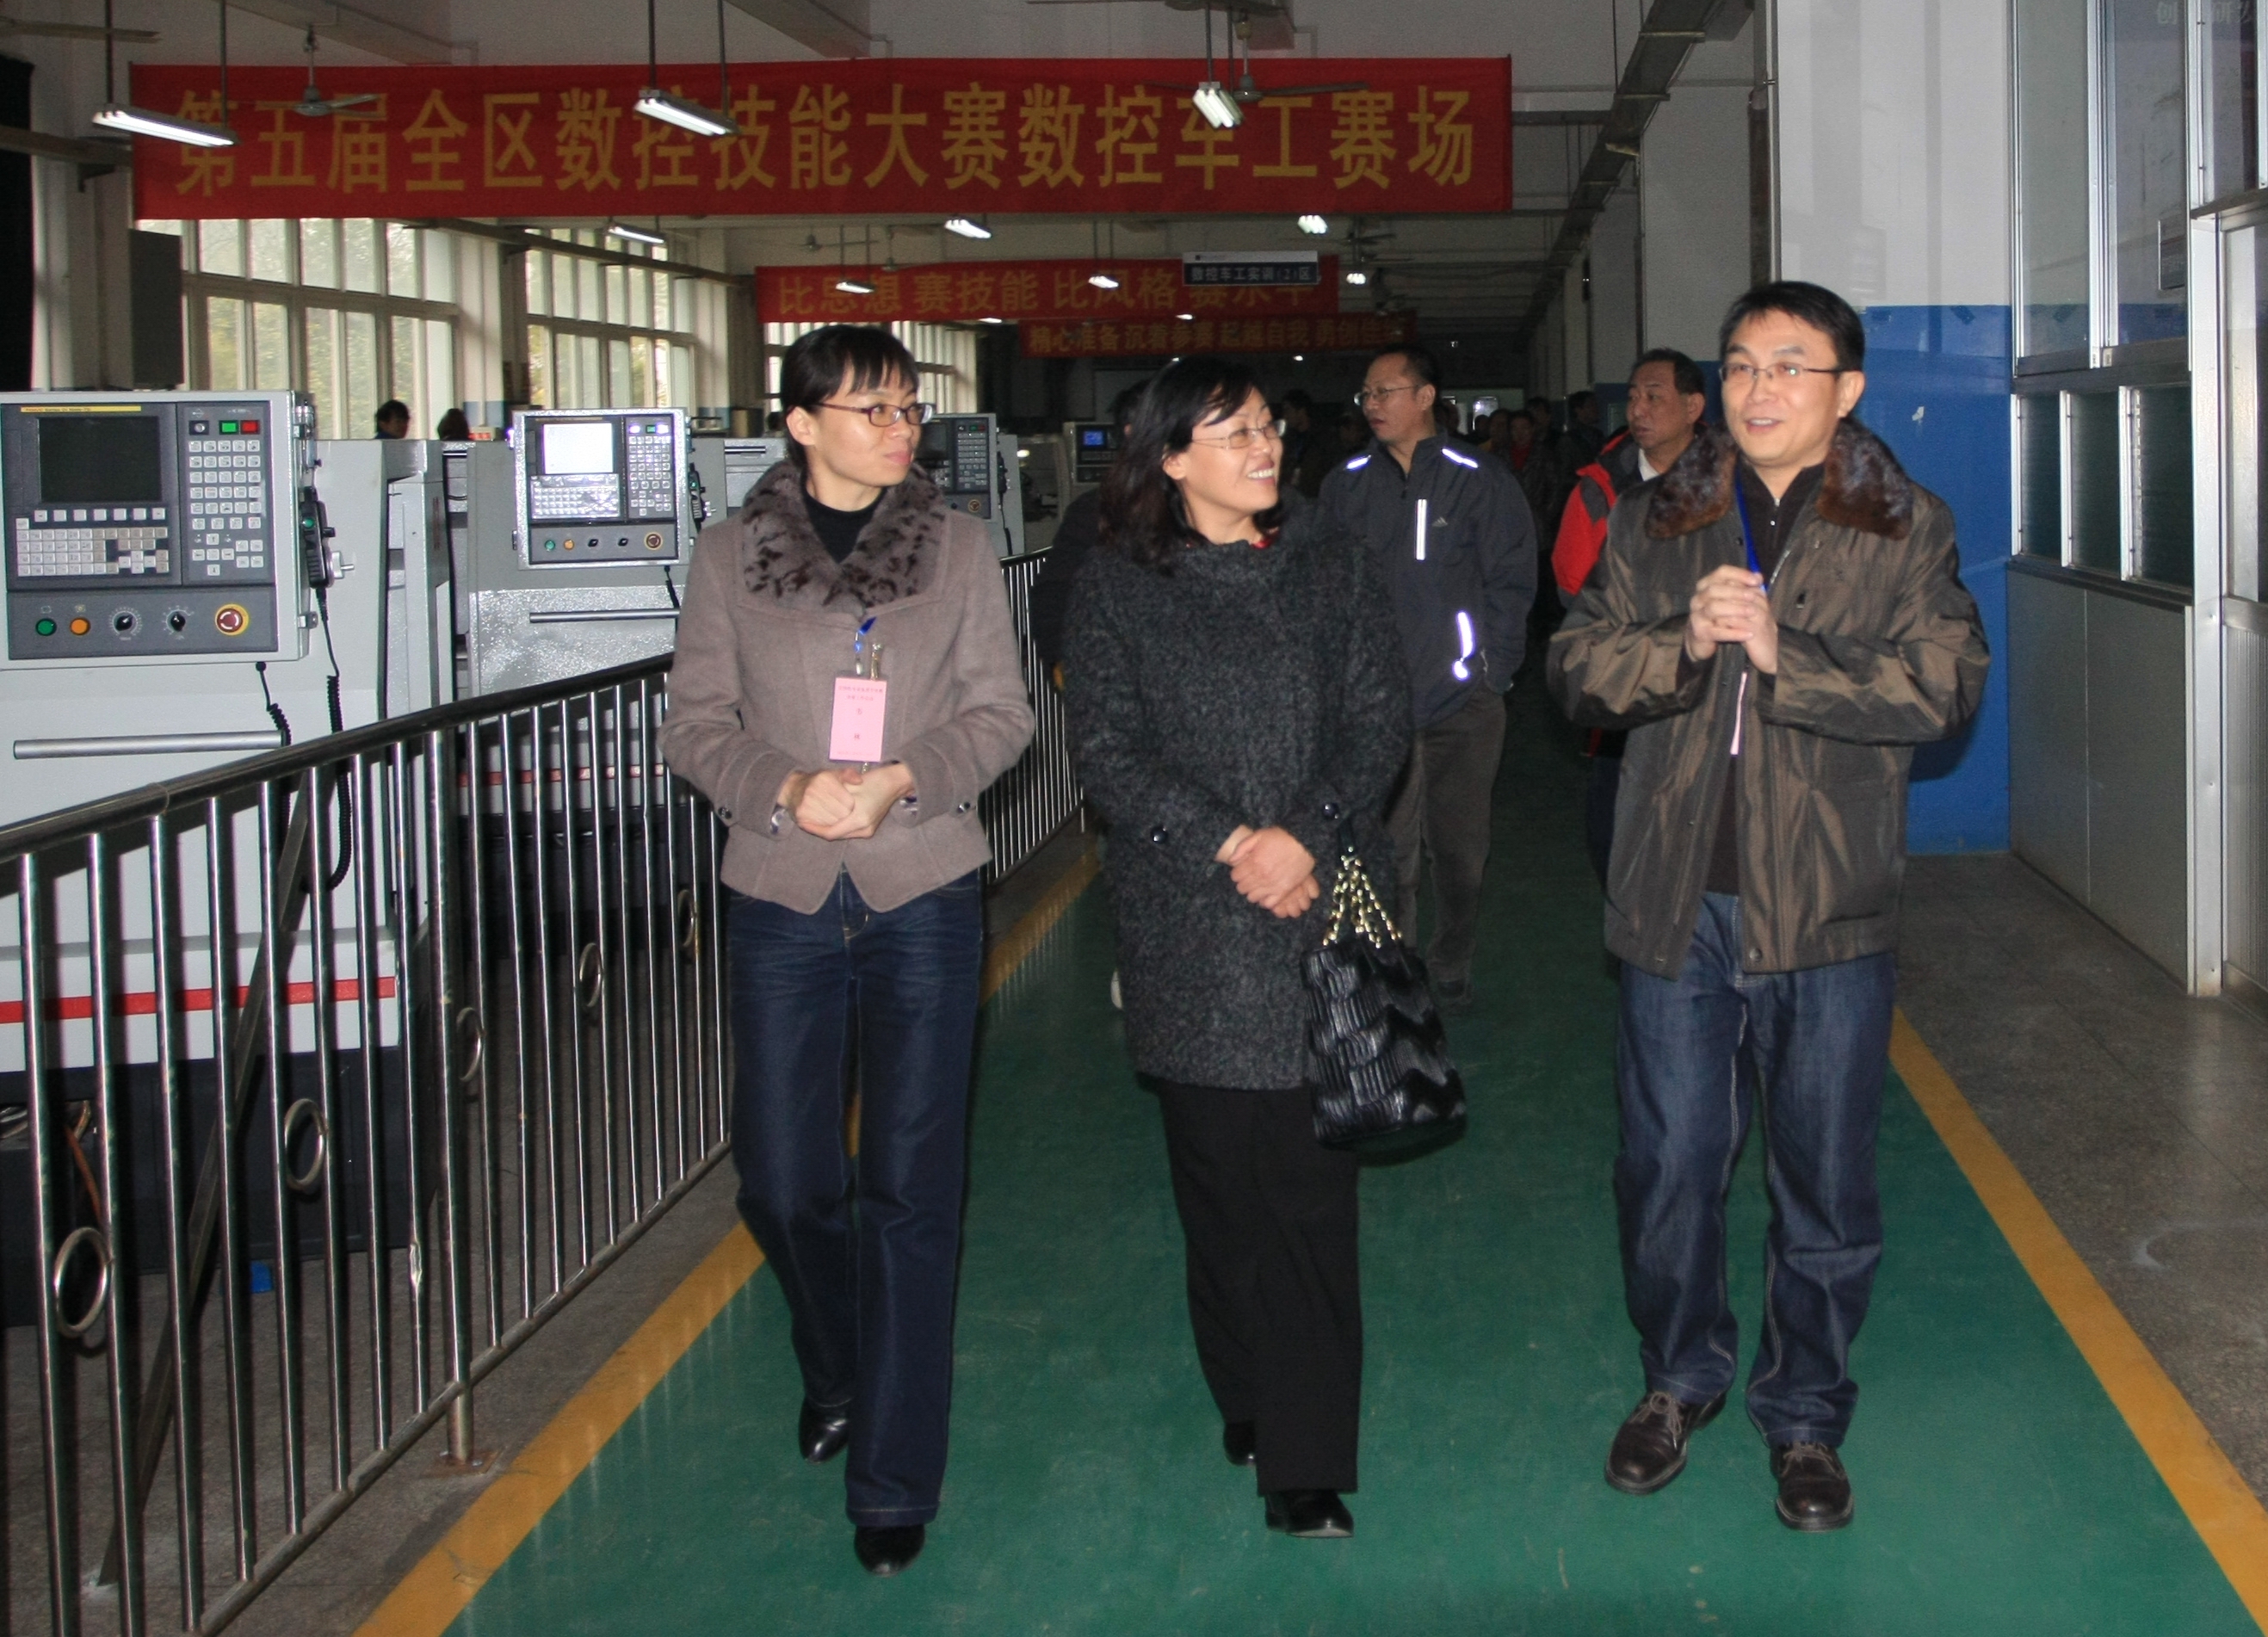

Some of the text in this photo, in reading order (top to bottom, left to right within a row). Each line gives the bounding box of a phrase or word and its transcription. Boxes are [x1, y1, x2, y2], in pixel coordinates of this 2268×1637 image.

[176, 83, 1474, 196] 第五届全区数控技能大赛数控车工赛场
[778, 273, 902, 315] 比思想
[913, 269, 1039, 314] 赛技能
